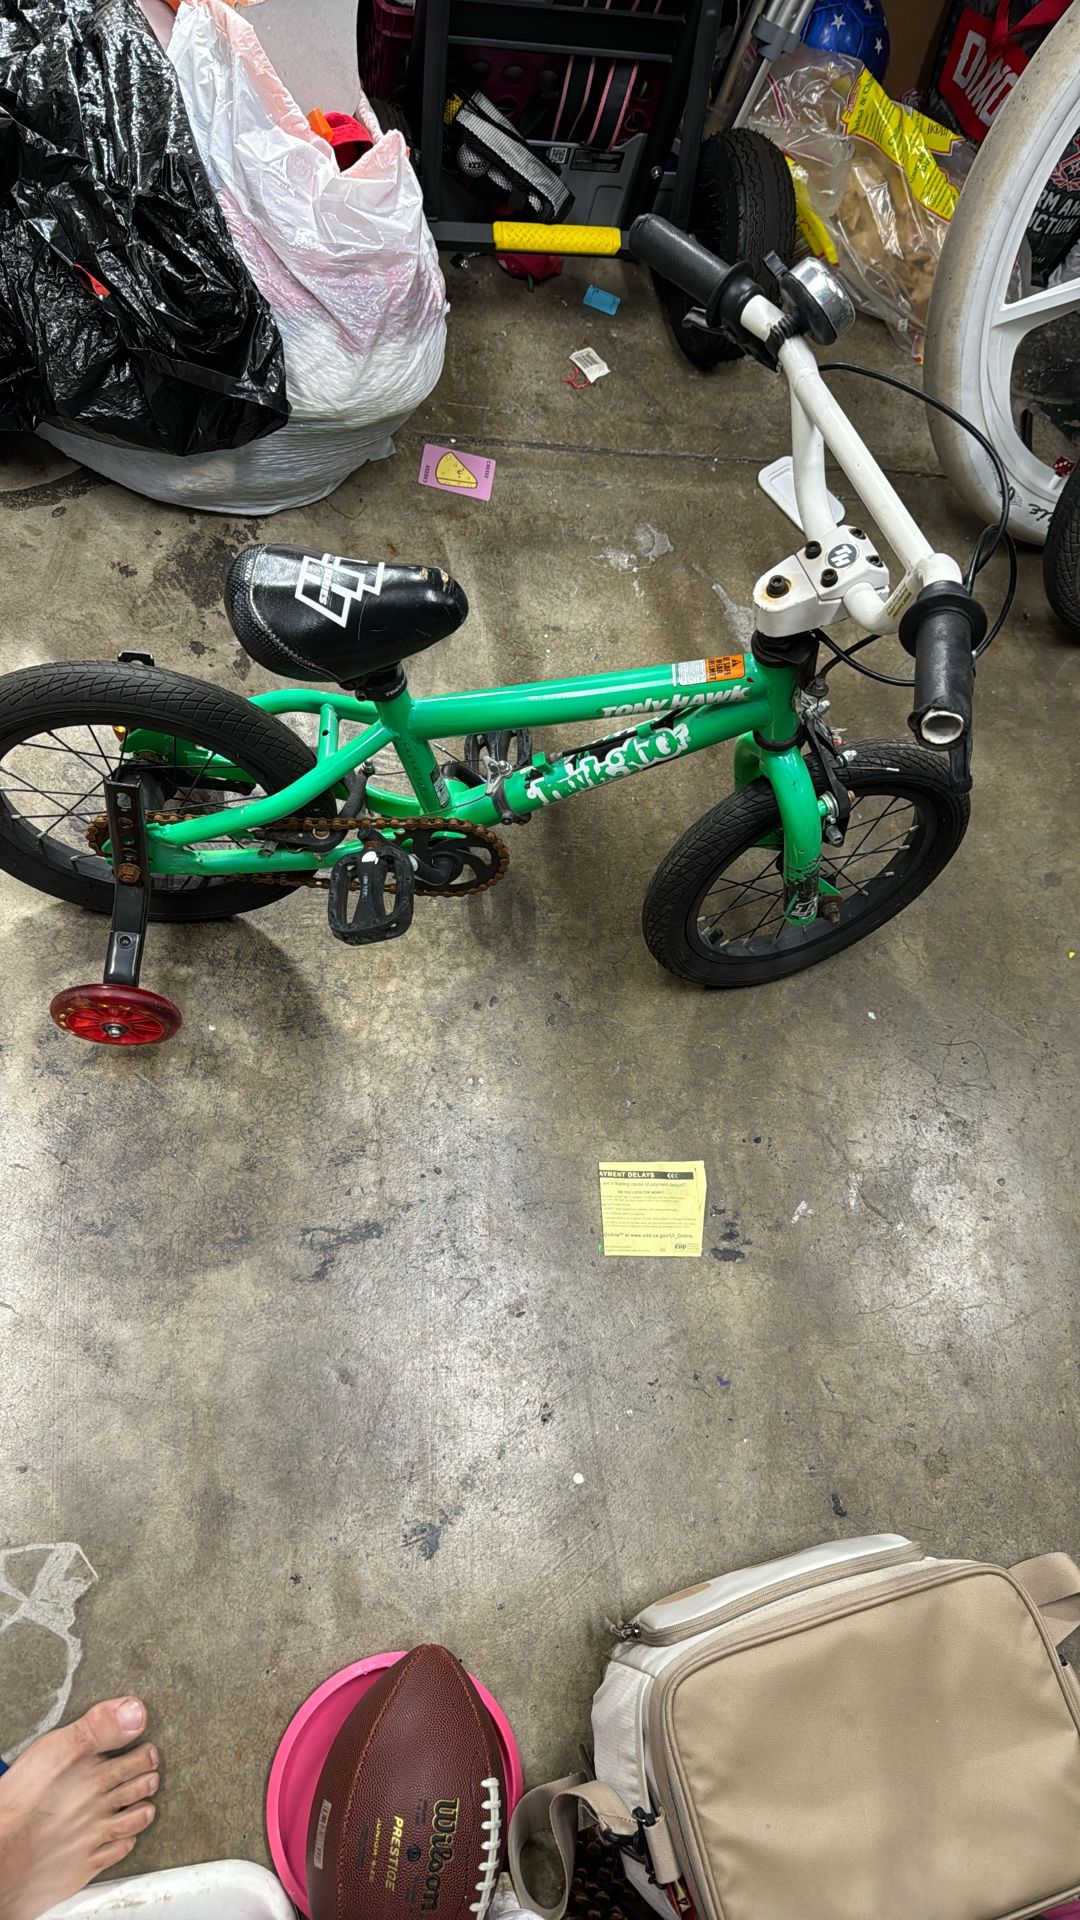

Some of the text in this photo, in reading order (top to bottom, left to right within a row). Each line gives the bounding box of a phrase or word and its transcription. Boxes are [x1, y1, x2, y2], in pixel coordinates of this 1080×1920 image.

[601, 685, 750, 718] TONY HAWK
[385, 1815, 405, 1892] PRESTIGE
[421, 1797, 461, 1910] Wilson
